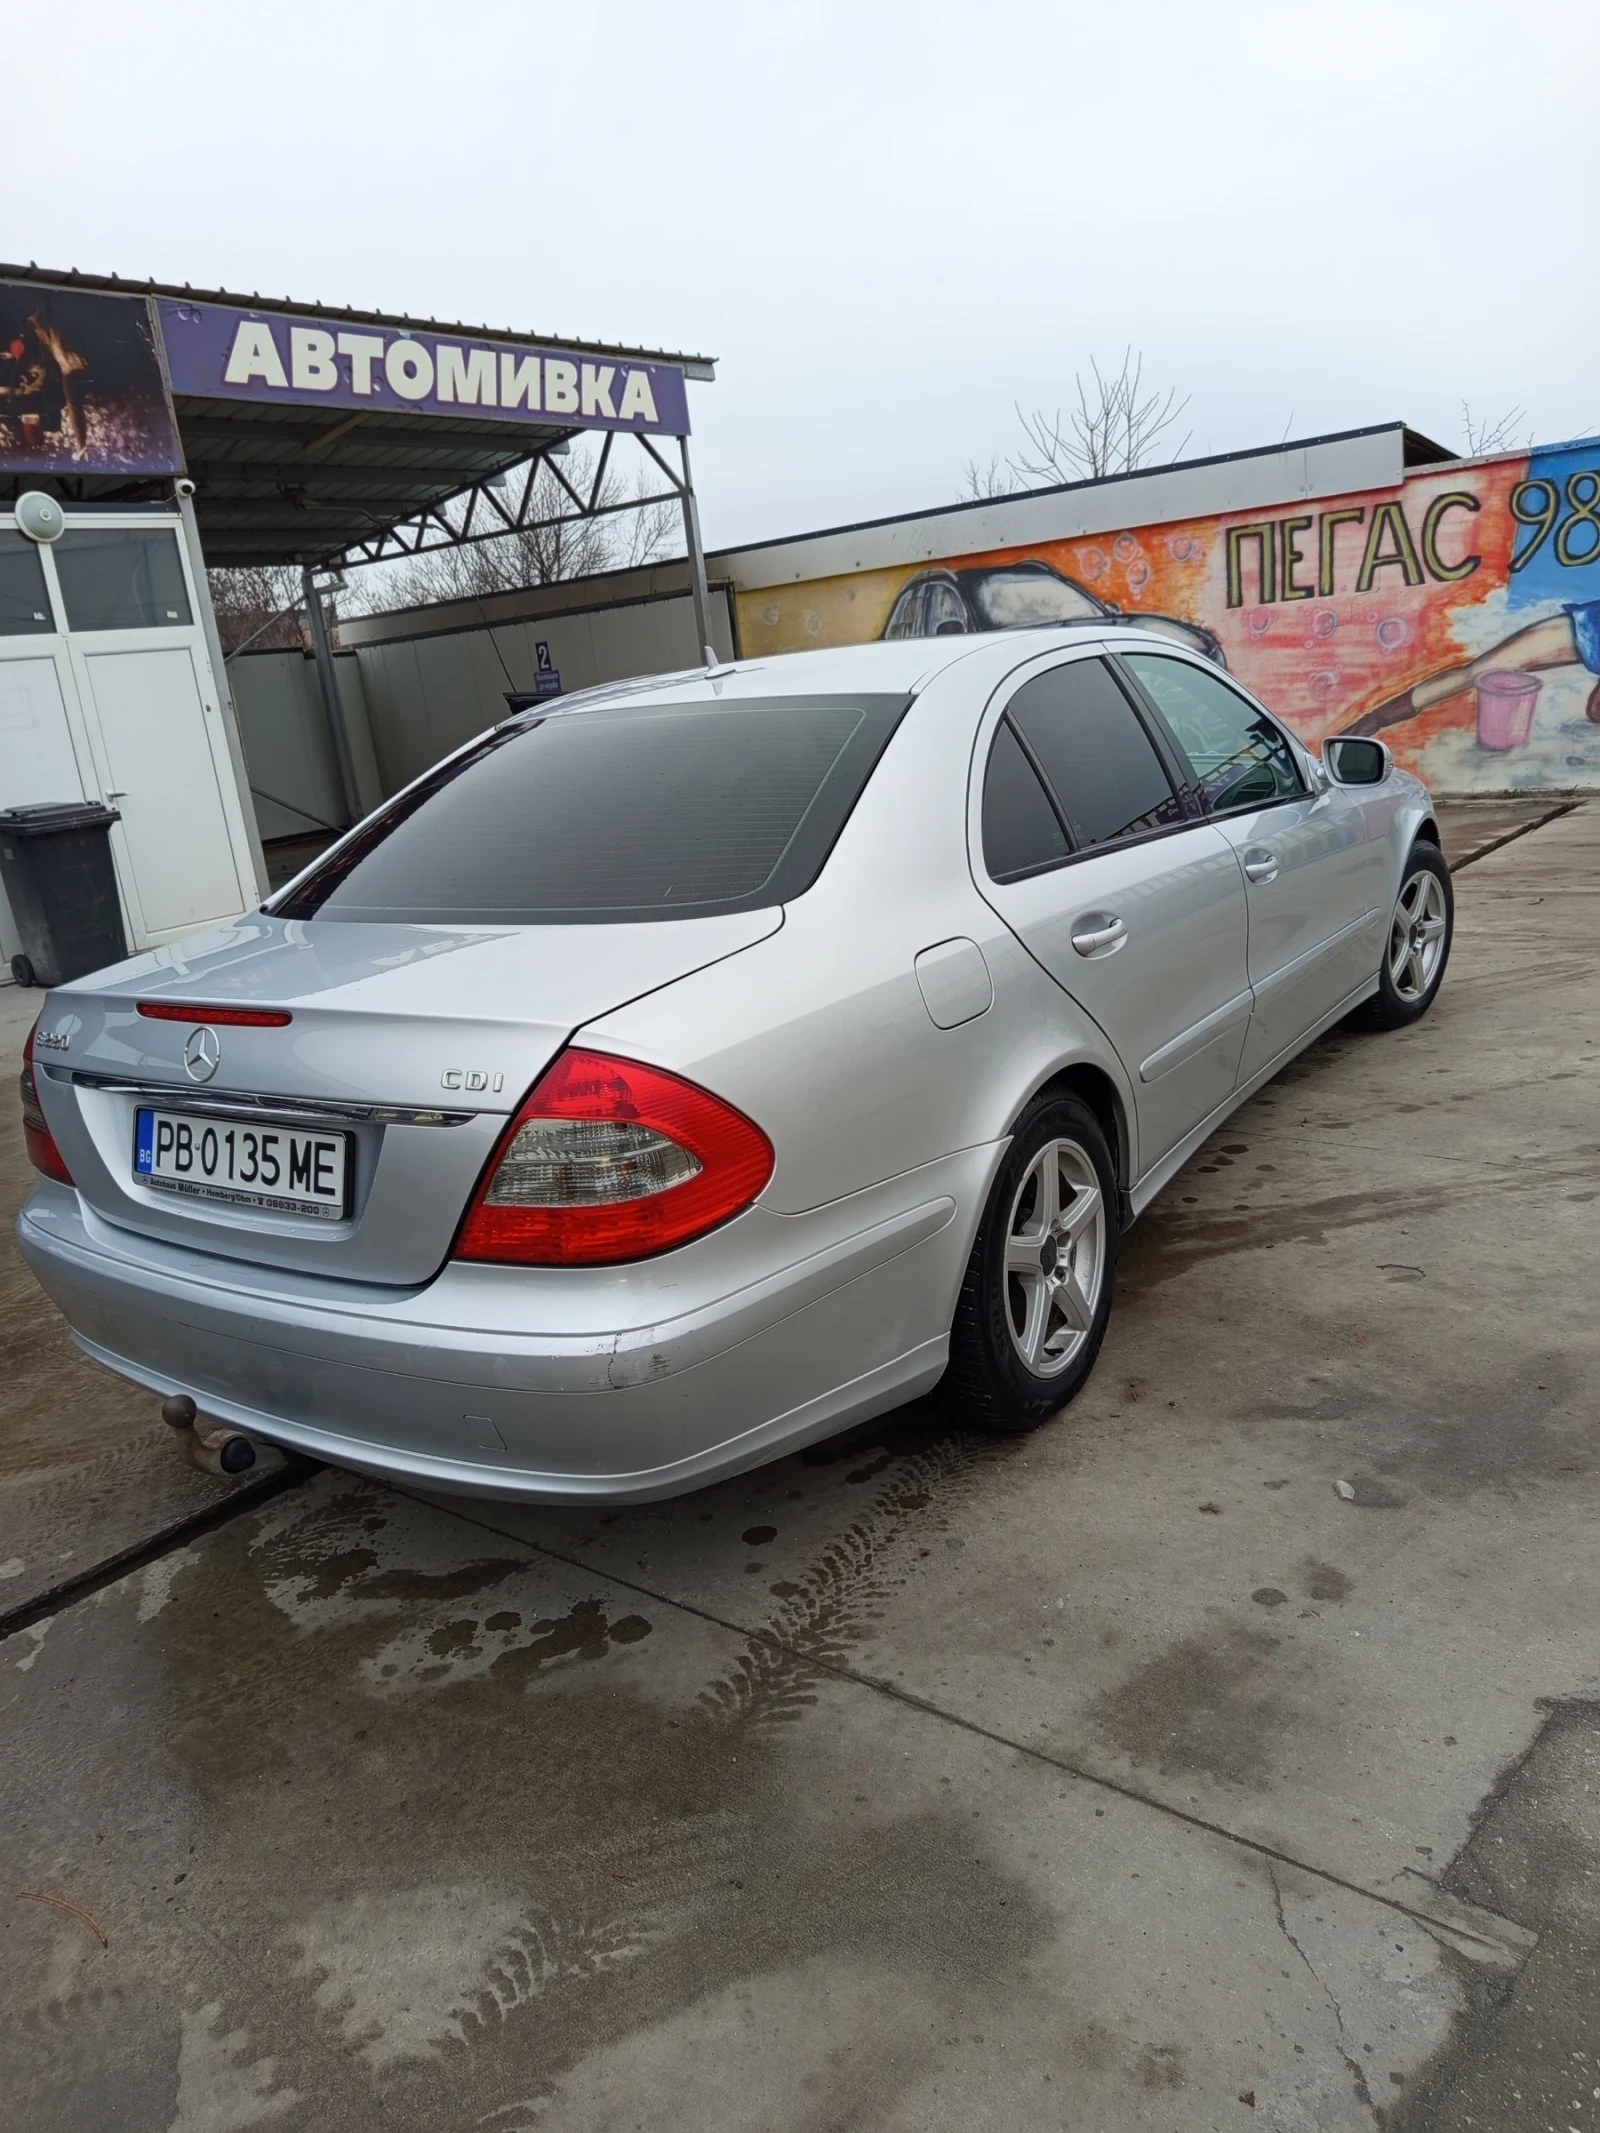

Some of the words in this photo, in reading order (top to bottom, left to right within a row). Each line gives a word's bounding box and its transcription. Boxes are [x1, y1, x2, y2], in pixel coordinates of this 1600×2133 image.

[224, 320, 659, 423] АВТОМИВКА
[1226, 492, 1481, 609] ПЕГАС
[538, 645, 549, 669] 2
[440, 1068, 504, 1093] CDI
[139, 1148, 151, 1163] BG
[156, 1120, 193, 1172] PB
[201, 1127, 281, 1186] 0135
[289, 1138, 337, 1196] ME
[150, 1178, 176, 1190] Autohaus
[178, 1183, 200, 1195] Müller
